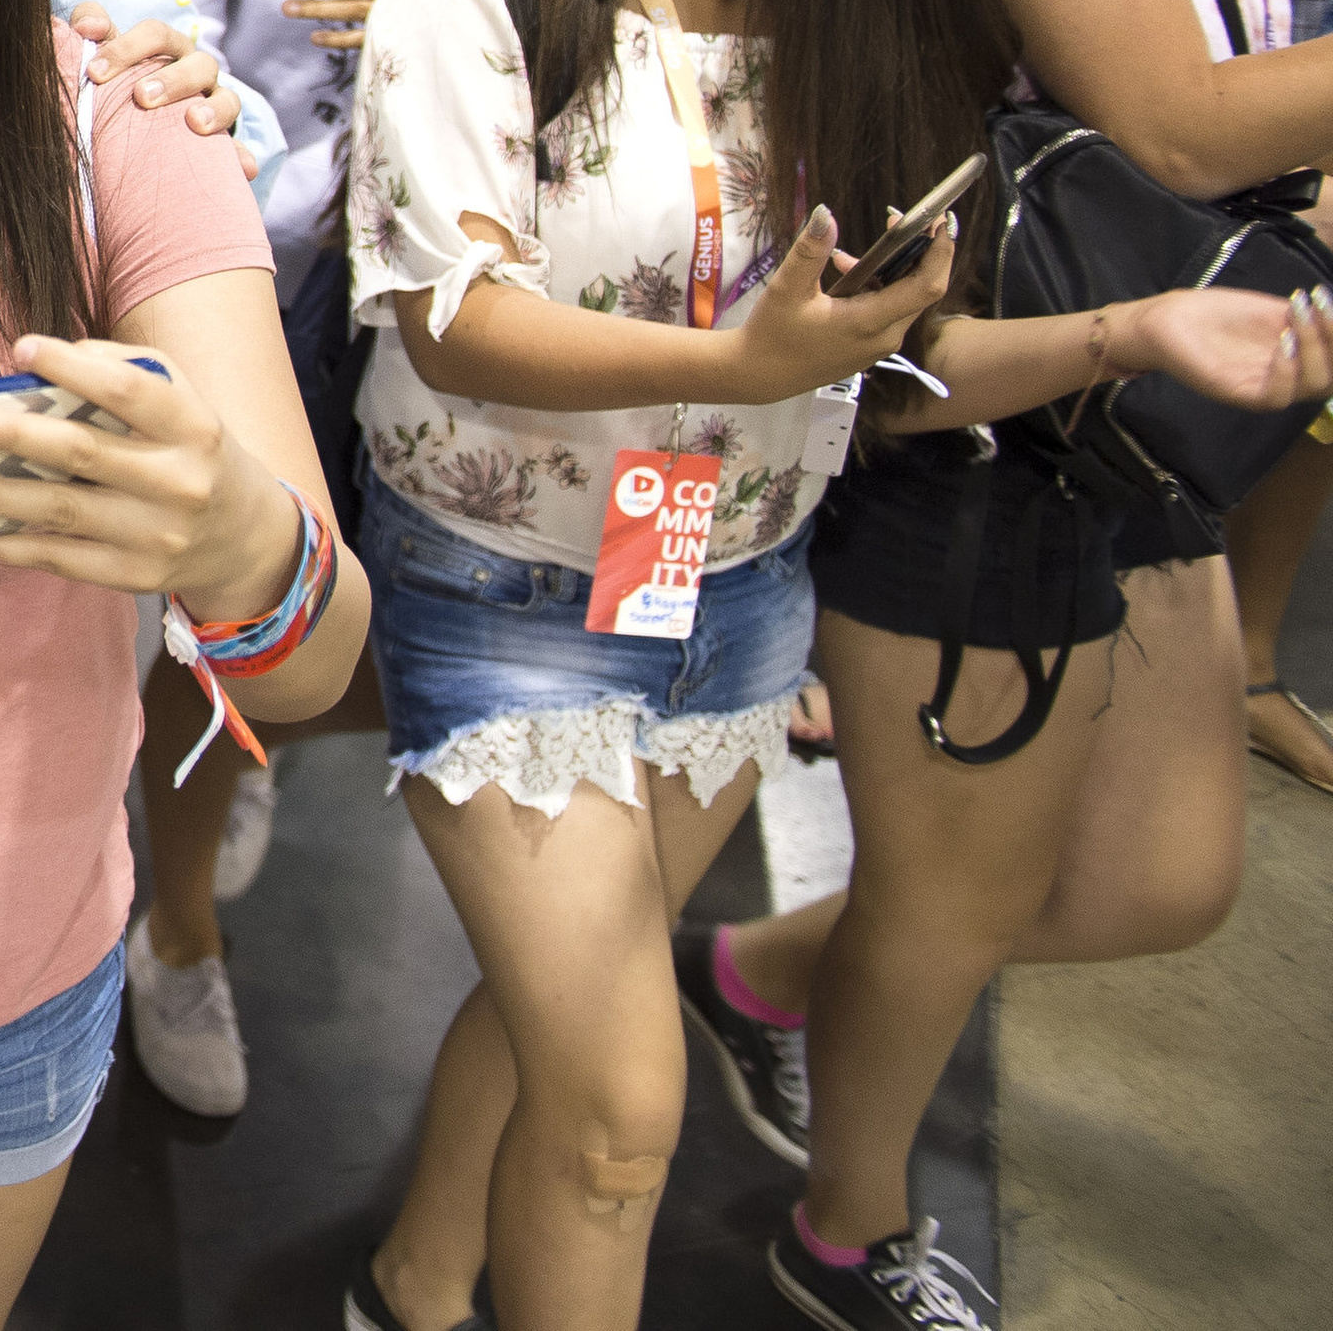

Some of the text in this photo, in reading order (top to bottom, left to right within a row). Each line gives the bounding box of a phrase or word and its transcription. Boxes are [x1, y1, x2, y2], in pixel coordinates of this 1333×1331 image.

[694, 216, 714, 281] GENIUS
[740, 256, 774, 289] NIUS
[673, 480, 717, 508] CO
[655, 507, 713, 536] MM
[662, 535, 708, 563] UN
[651, 562, 704, 588] ITY
